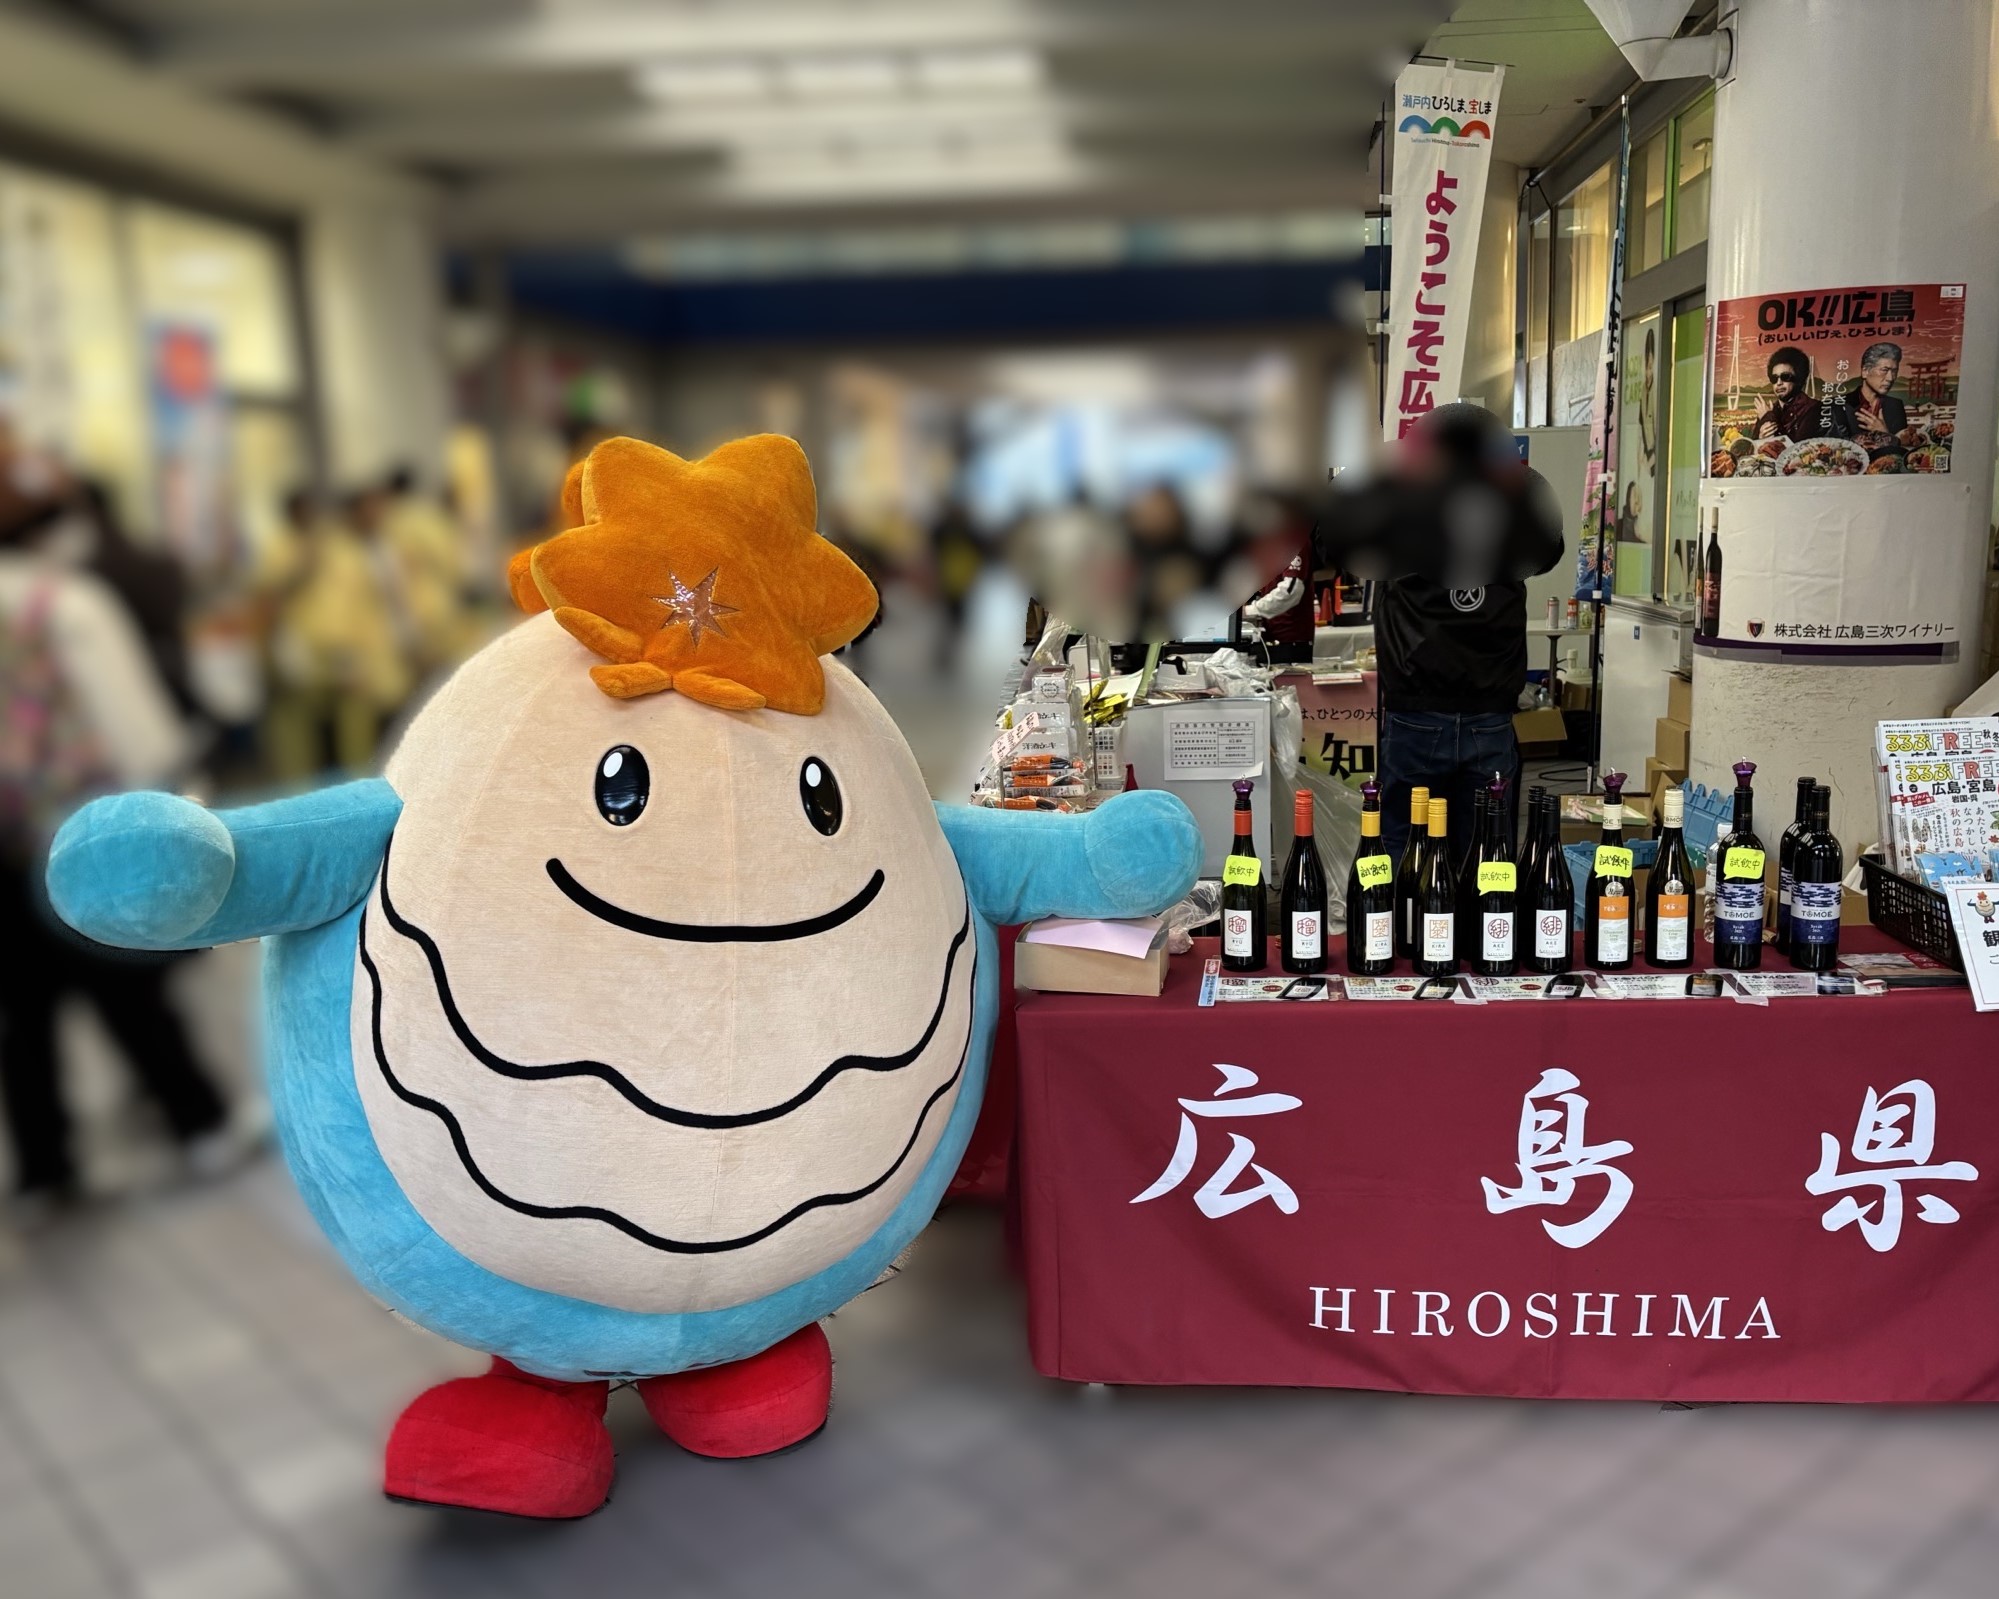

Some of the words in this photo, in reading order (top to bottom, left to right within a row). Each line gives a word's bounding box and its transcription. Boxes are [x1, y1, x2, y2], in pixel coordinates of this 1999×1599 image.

[1402, 94, 1492, 115] 瀬戸内ひろしま、宝しま
[1398, 169, 1458, 440] ようこそ広
[1299, 733, 1375, 780] 知
[1931, 779, 1996, 795] 広島・宮島
[1950, 808, 1964, 848] 秋の広島
[1128, 1062, 1981, 1252] 広島県
[1308, 1286, 1781, 1341] HIROSHIMA
